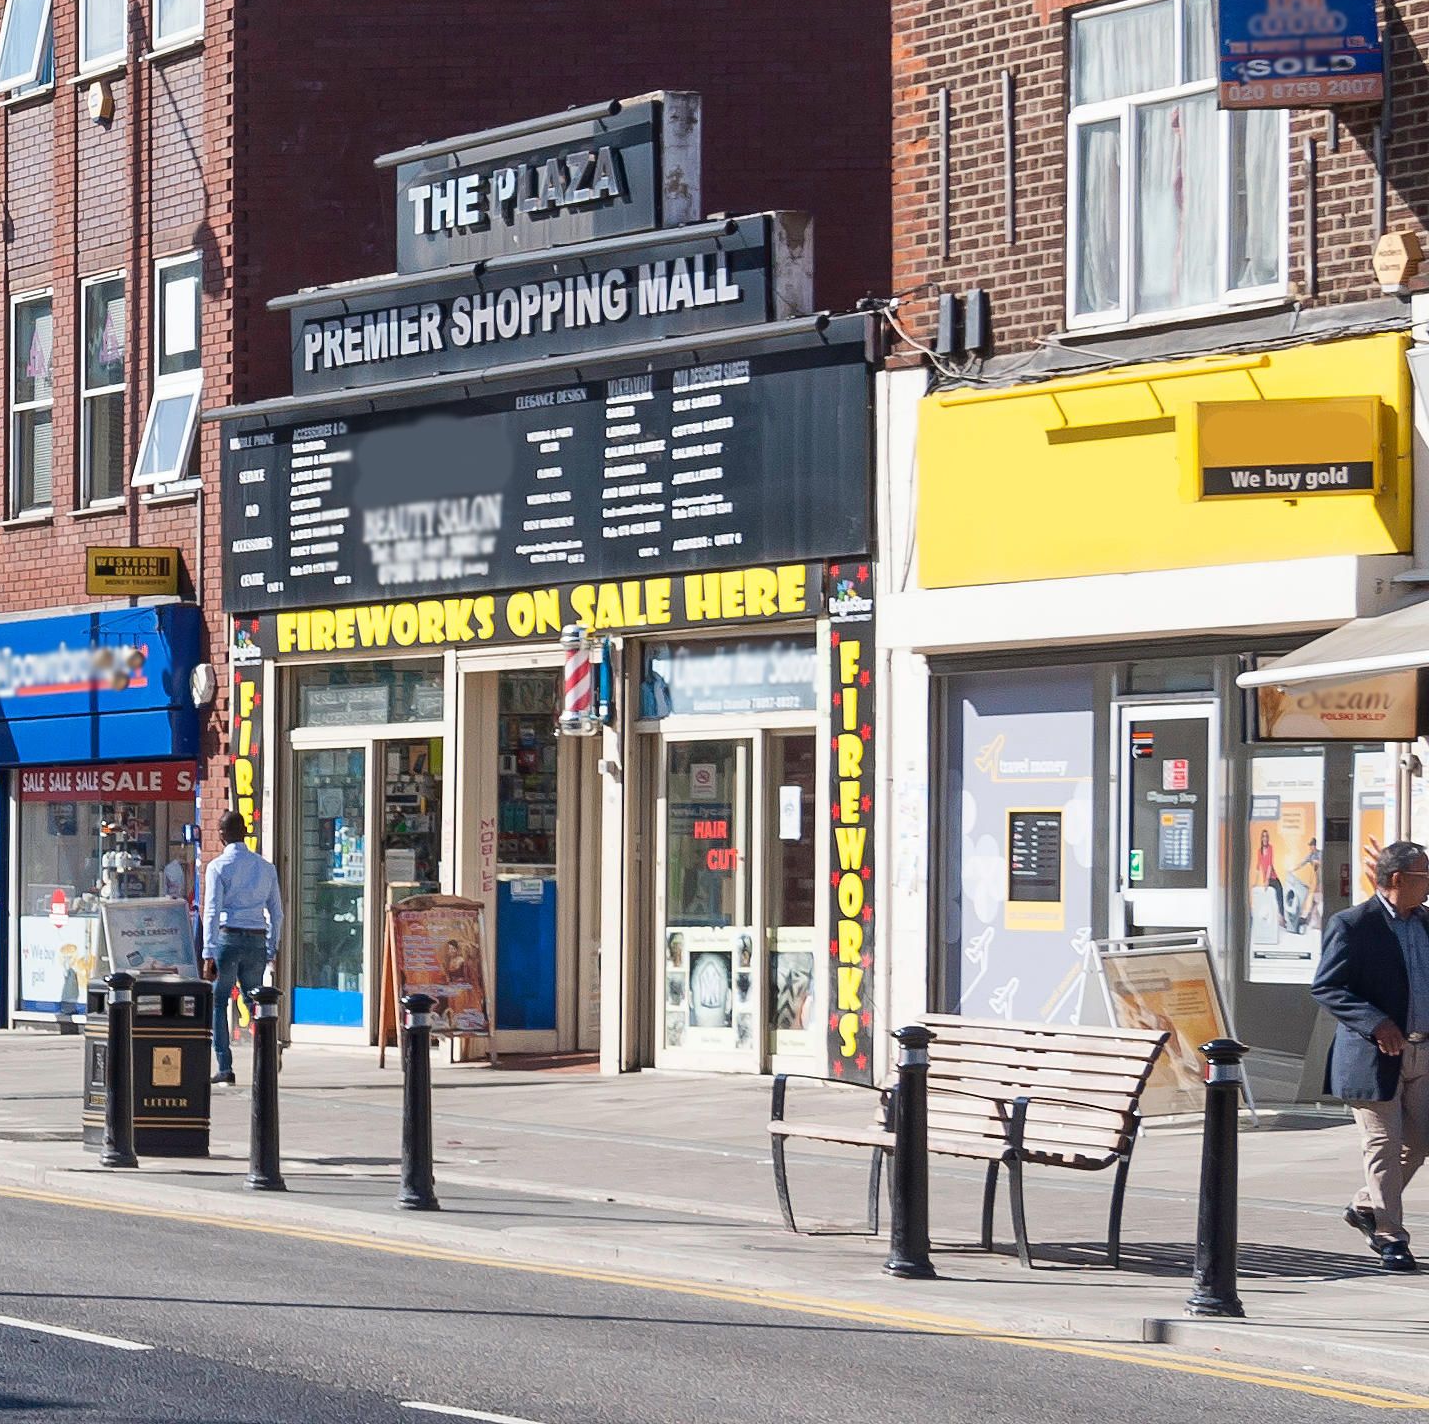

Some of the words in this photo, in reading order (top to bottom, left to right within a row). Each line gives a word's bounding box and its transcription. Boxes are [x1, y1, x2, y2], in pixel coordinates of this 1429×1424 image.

[1247, 54, 1356, 76] SOLD
[1229, 85, 1264, 101] 020
[408, 174, 479, 235] THE
[493, 146, 619, 217] PLAZA
[304, 303, 442, 371] PREMIER
[452, 268, 627, 346] SHOPPING
[638, 251, 740, 315] MALL
[515, 390, 555, 410] ELEGANCE
[557, 388, 587, 404] DESIGN
[253, 433, 275, 447] PHONE
[239, 468, 265, 484] SERVICE
[1231, 472, 1260, 488] We
[1265, 469, 1300, 490] buy
[1305, 466, 1349, 490] gold
[245, 504, 259, 518] AND
[363, 500, 436, 543] BEAUTY
[438, 493, 503, 535] SALON
[232, 537, 273, 553] ACCESSORIES
[96, 557, 157, 567] WESTERN
[115, 567, 157, 576] UNION
[241, 572, 265, 587] CENTRE
[276, 595, 495, 653] FIREWORKS
[506, 588, 562, 638] ON
[570, 577, 672, 634] SALE
[684, 564, 806, 621] HERE
[1320, 713, 1354, 721] POLSKI
[1357, 712, 1387, 721] SKLEP
[1000, 758, 1029, 774] travel
[1030, 759, 1069, 776] money
[23, 771, 45, 792] SALE
[49, 771, 72, 792] SALE
[76, 770, 99, 792] SALE
[101, 770, 162, 792] SALE
[694, 821, 727, 839] HAIR
[481, 818, 494, 892] MOBILE
[835, 640, 866, 1057] FIREWORKS
[707, 848, 738, 871] CUT
[121, 930, 147, 938] POOR
[31, 945, 43, 959] We
[143, 1097, 189, 1107] LITTER
